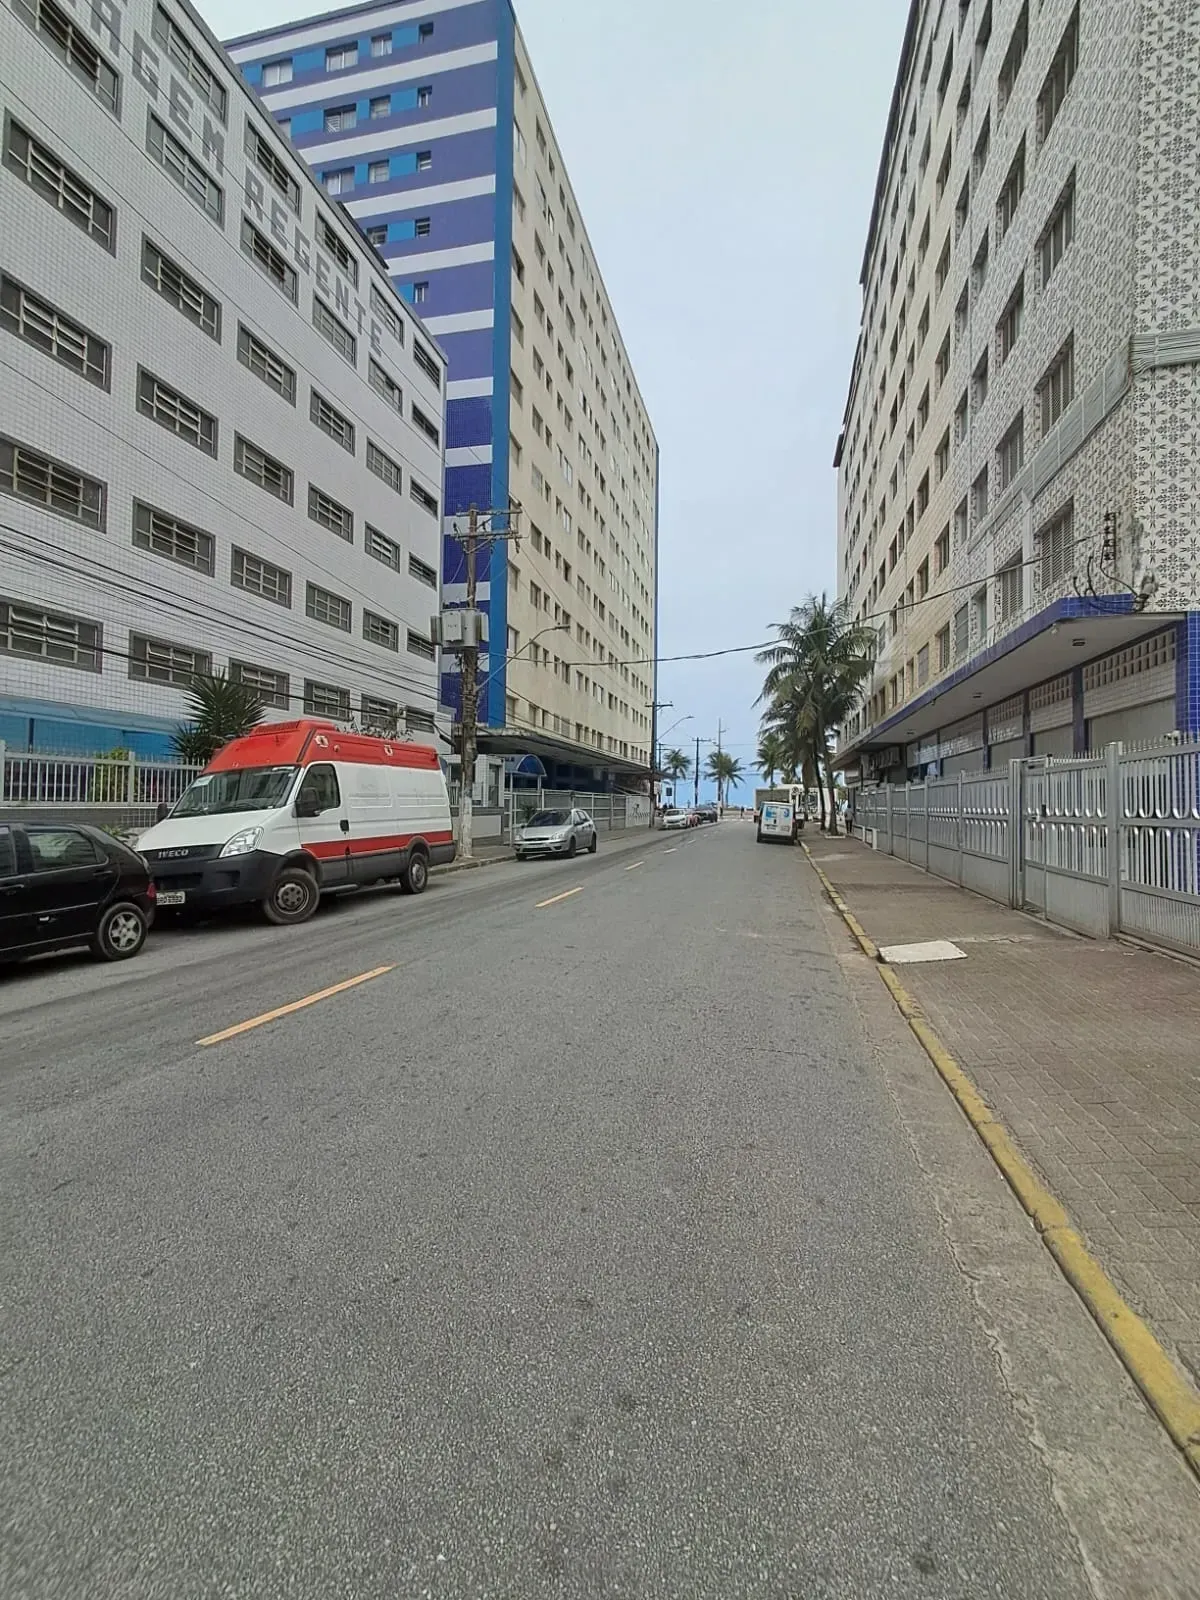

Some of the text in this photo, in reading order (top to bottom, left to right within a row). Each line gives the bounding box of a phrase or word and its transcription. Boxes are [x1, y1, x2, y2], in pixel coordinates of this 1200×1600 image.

[68, 0, 383, 357] AGEM REGENTE
[158, 849, 189, 858] IVECO
